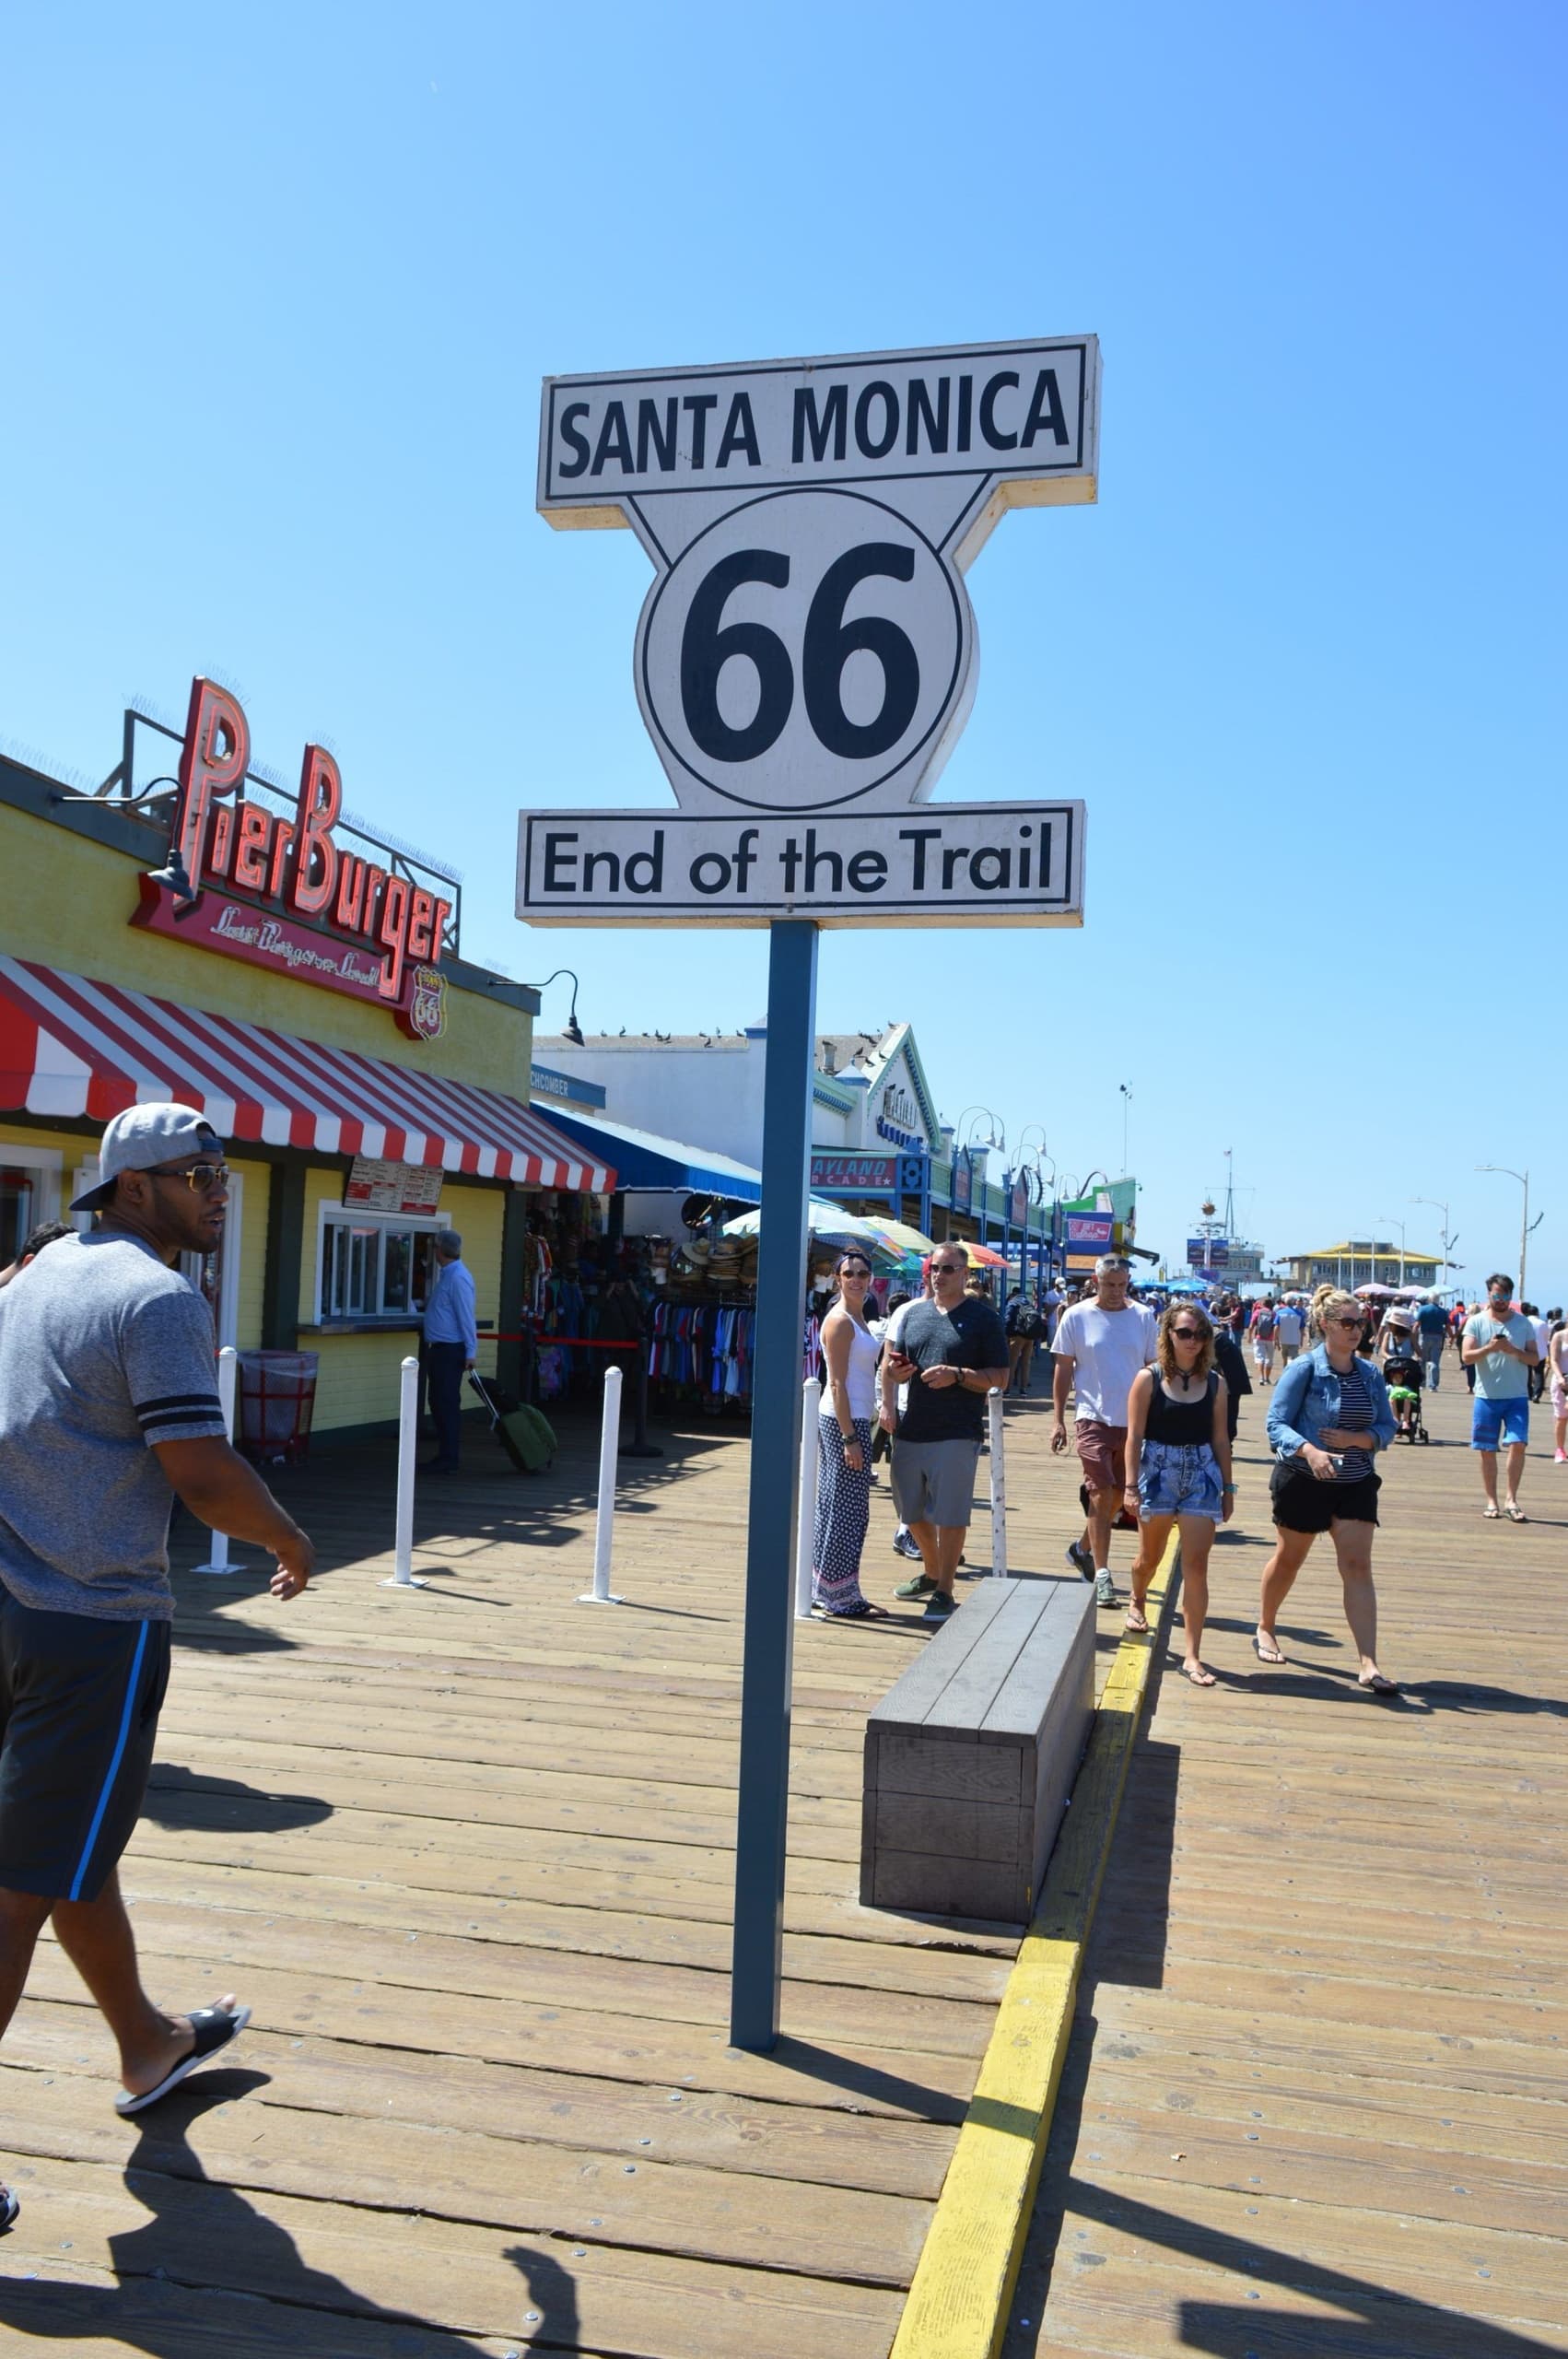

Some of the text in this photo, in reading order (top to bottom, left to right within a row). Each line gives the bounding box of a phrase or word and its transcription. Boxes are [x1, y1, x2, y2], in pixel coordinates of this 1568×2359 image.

[557, 368, 1071, 478] SANTA MONICA
[680, 541, 920, 764] 66
[543, 822, 1053, 894] End of the Trail
[415, 994, 443, 1027] 66
[531, 1071, 568, 1097] CHCOMBER
[811, 1175, 882, 1186] RCADE
[812, 1159, 886, 1175] AYLAND
